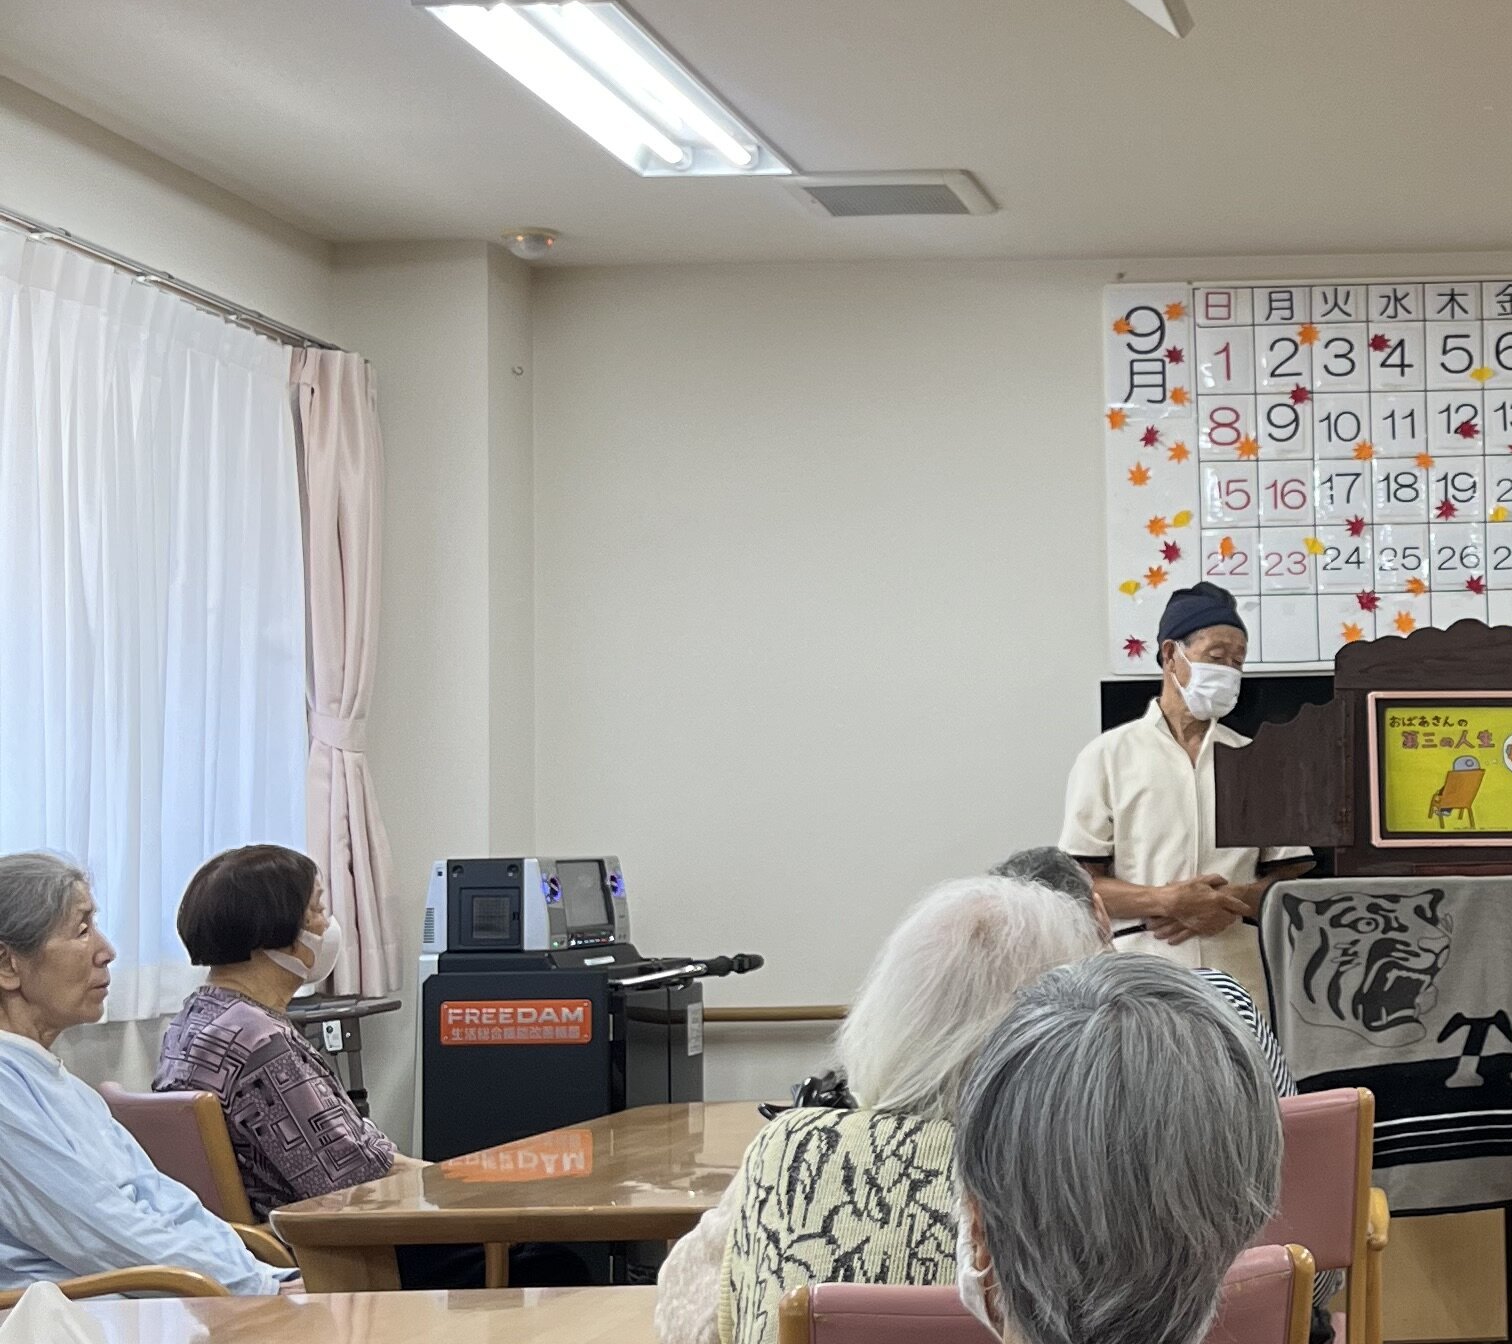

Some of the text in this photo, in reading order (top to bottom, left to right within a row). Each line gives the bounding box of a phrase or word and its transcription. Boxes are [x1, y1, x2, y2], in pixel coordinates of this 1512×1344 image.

[1205, 292, 1232, 321] 日
[1266, 291, 1294, 321] 月
[1320, 289, 1352, 318] 火
[1379, 289, 1413, 319] 水
[1437, 288, 1470, 318] 木
[1124, 305, 1166, 405] 9月
[1214, 341, 1232, 381] 1
[1270, 338, 1300, 377] 2
[1323, 338, 1356, 377] 3
[1379, 338, 1413, 377] 4
[1440, 334, 1474, 374] 5
[1208, 406, 1241, 446] 8
[1266, 403, 1300, 442] 9
[1319, 411, 1361, 443] 10
[1383, 409, 1416, 440] 11
[1438, 403, 1478, 434] 12
[1217, 478, 1251, 510] 15
[1265, 478, 1307, 510] 16
[1322, 472, 1362, 505] 17
[1379, 471, 1420, 503] 18
[1437, 472, 1477, 503] 19
[1206, 549, 1249, 577] 22
[1264, 552, 1307, 577] 23
[1322, 547, 1365, 571] 24
[1378, 545, 1421, 571] 25
[1436, 544, 1480, 570] 26
[448, 1007, 584, 1024] FREEDAM
